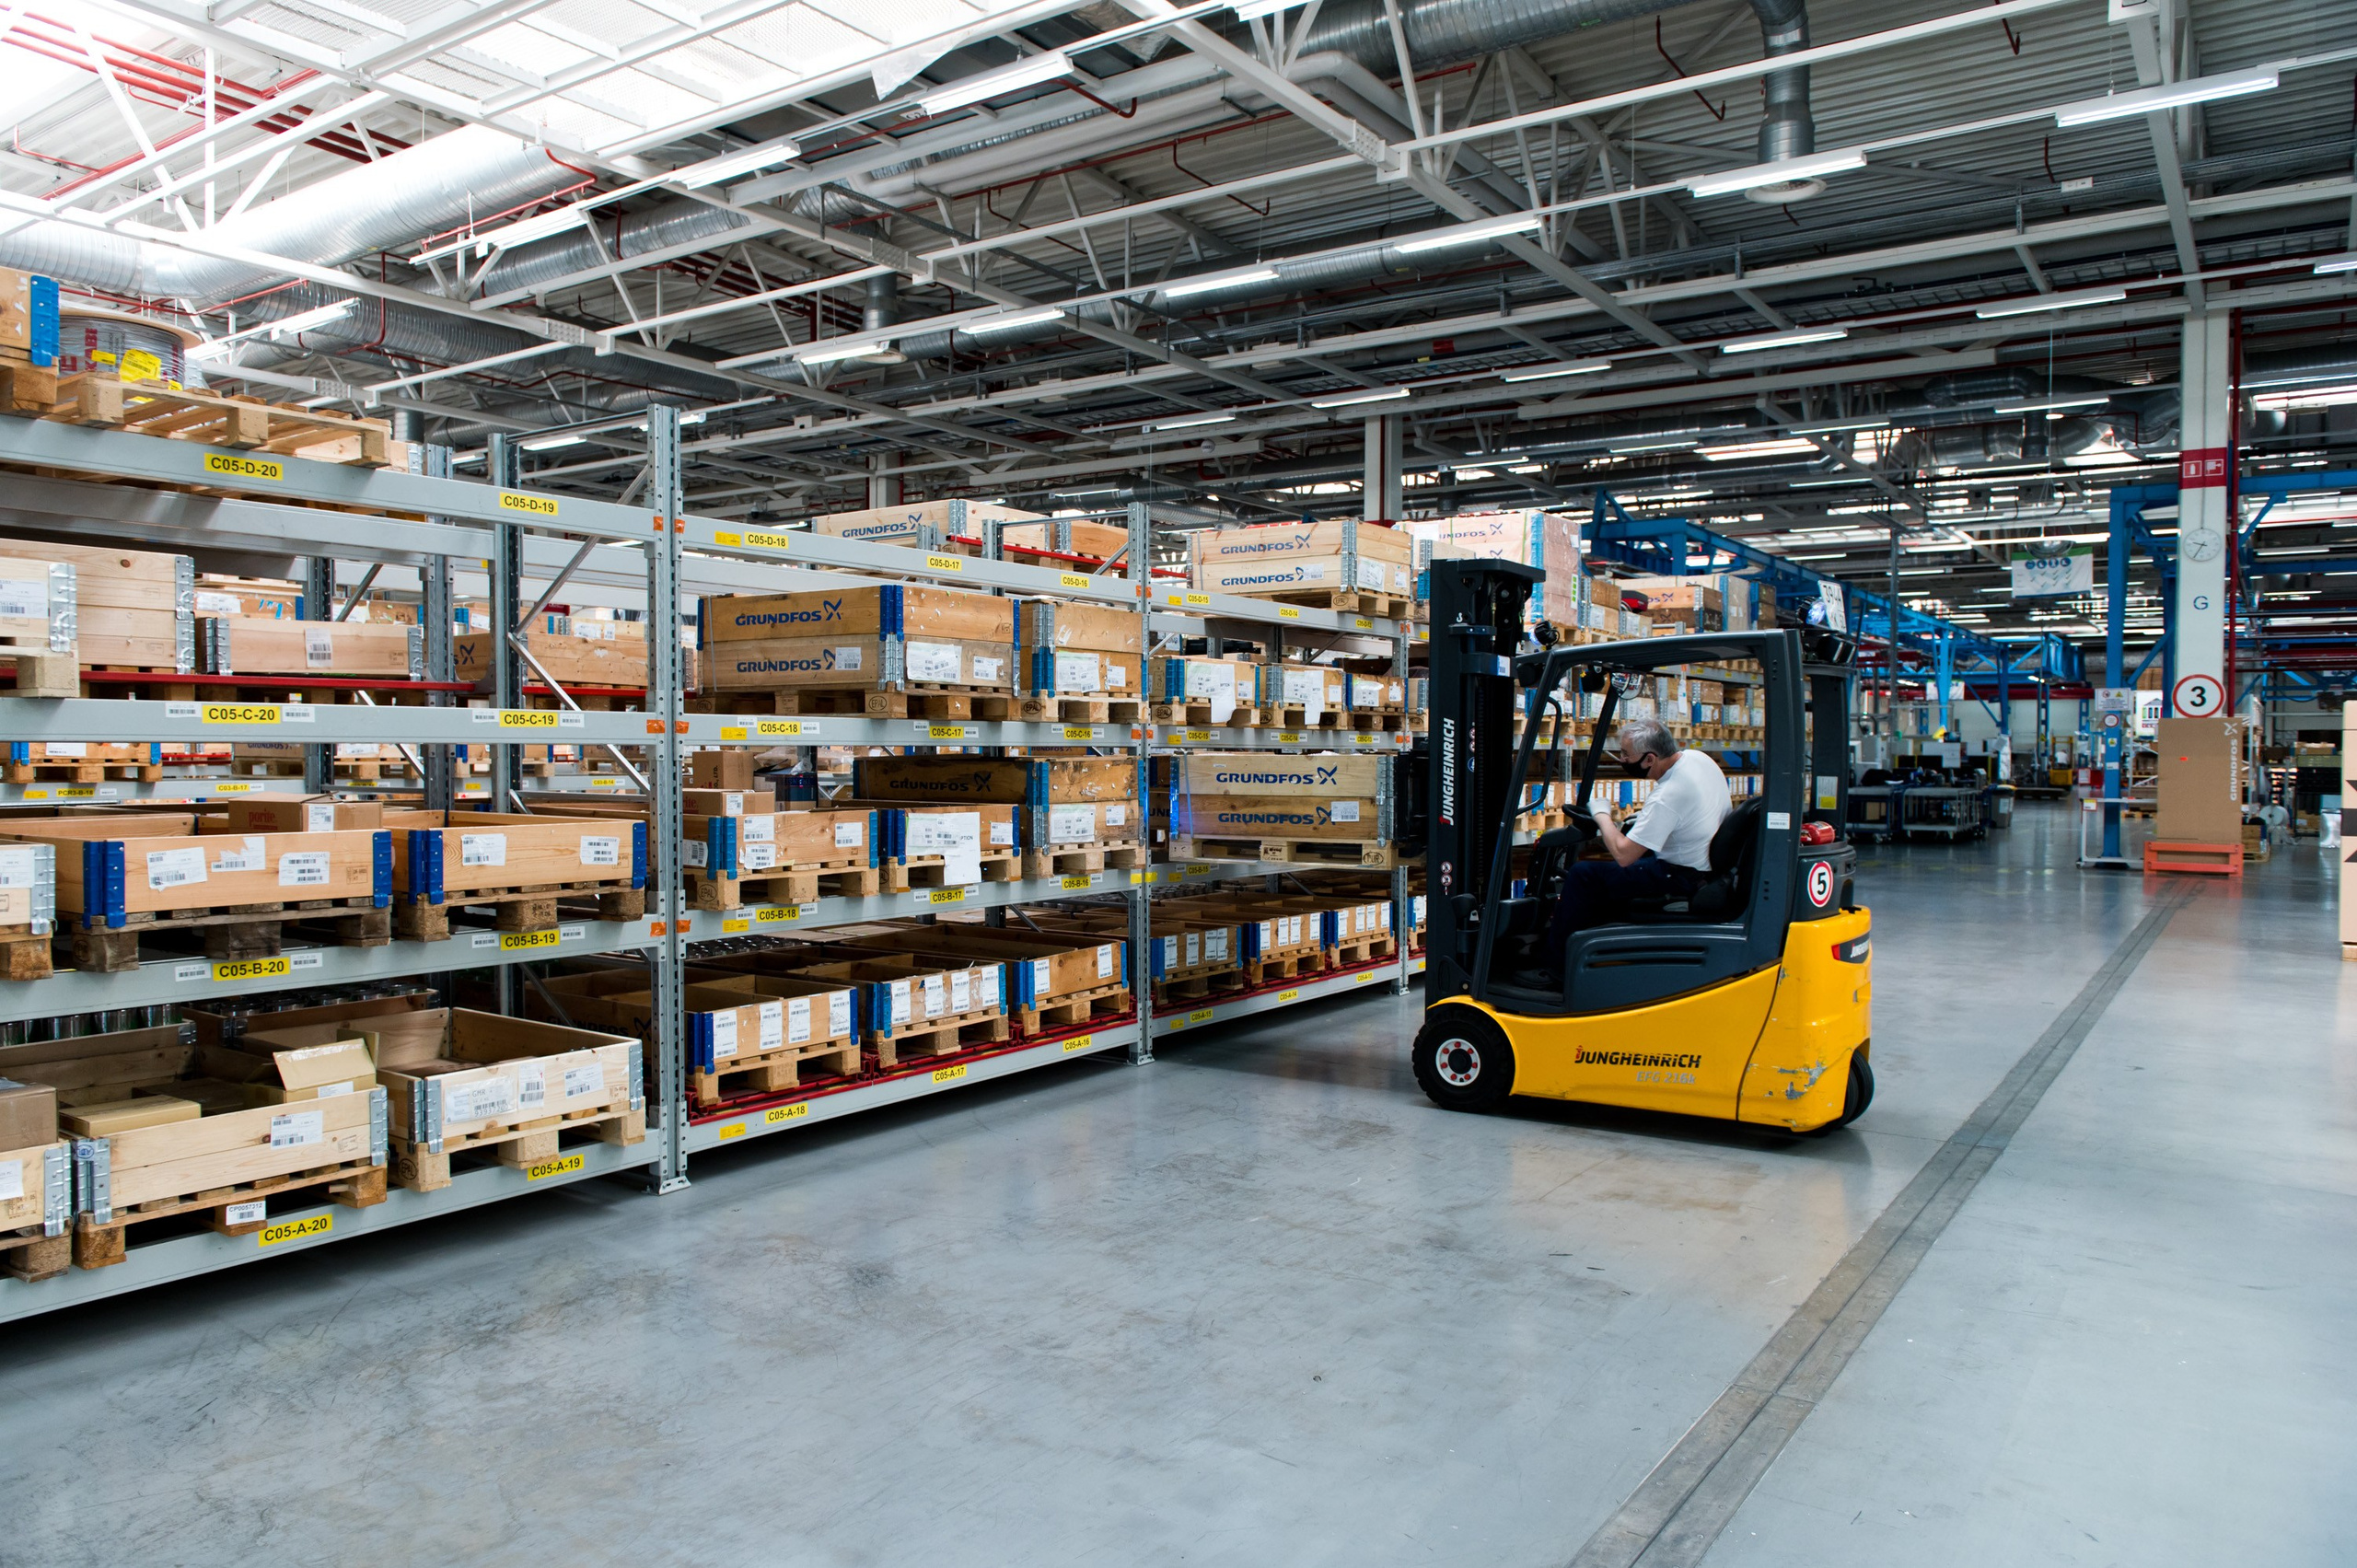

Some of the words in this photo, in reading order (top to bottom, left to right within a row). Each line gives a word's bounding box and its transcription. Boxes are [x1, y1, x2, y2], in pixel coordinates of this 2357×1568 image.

[210, 458, 277, 477] C05-D-20
[504, 496, 554, 513] C05-D-19
[842, 521, 908, 539] GRUNDFOS
[748, 535, 786, 547] C05-D-18
[1220, 540, 1294, 555] GRUNDFOS
[929, 558, 959, 568] C05-D-17
[1063, 577, 1087, 587] C05-D-16
[1221, 573, 1294, 587] GRUNDFOS
[1188, 595, 1208, 603] C05-D-15
[2193, 595, 2209, 610] G
[735, 610, 822, 627] GRUNDFOS
[737, 659, 822, 674] GRUNDFOS
[870, 697, 888, 709] EPAL
[2190, 686, 2207, 707] 3
[1025, 703, 1039, 711] EPAL
[208, 708, 275, 721] C05-C-20
[504, 714, 554, 725] C05-C-19
[761, 724, 798, 733] C05-C-18
[932, 728, 961, 737] C05-C-17
[1066, 730, 1091, 738] C05-C-16
[1440, 717, 1455, 826] JUNGHEINRICH
[2229, 738, 2238, 802] GRUNDFOS
[1215, 772, 1314, 784] GRUNDFOS
[889, 779, 969, 793] GRUNDFOS
[1218, 812, 1314, 826] GRUNDFOS
[1064, 879, 1089, 889] C05-B-16
[1816, 872, 1829, 895] 5
[699, 885, 716, 900] EPAL
[933, 891, 962, 902] C05-B-17
[759, 909, 796, 921] C05-B-18
[506, 934, 555, 947] C05-B-19
[218, 961, 284, 978] C05-B-20
[1191, 1011, 1212, 1021] C05-A-15
[1064, 1038, 1090, 1050] C05-A-16
[1574, 1046, 1701, 1068] JUNGHEINRICH
[935, 1066, 965, 1082] C05-A-17
[1636, 1071, 1661, 1083] EFG
[1664, 1072, 1696, 1085] 216k
[768, 1105, 806, 1121] C05-A-18
[531, 1158, 580, 1178] C05-A-19
[228, 1202, 263, 1214] CP0057312
[264, 1218, 328, 1242] C05-A-20
